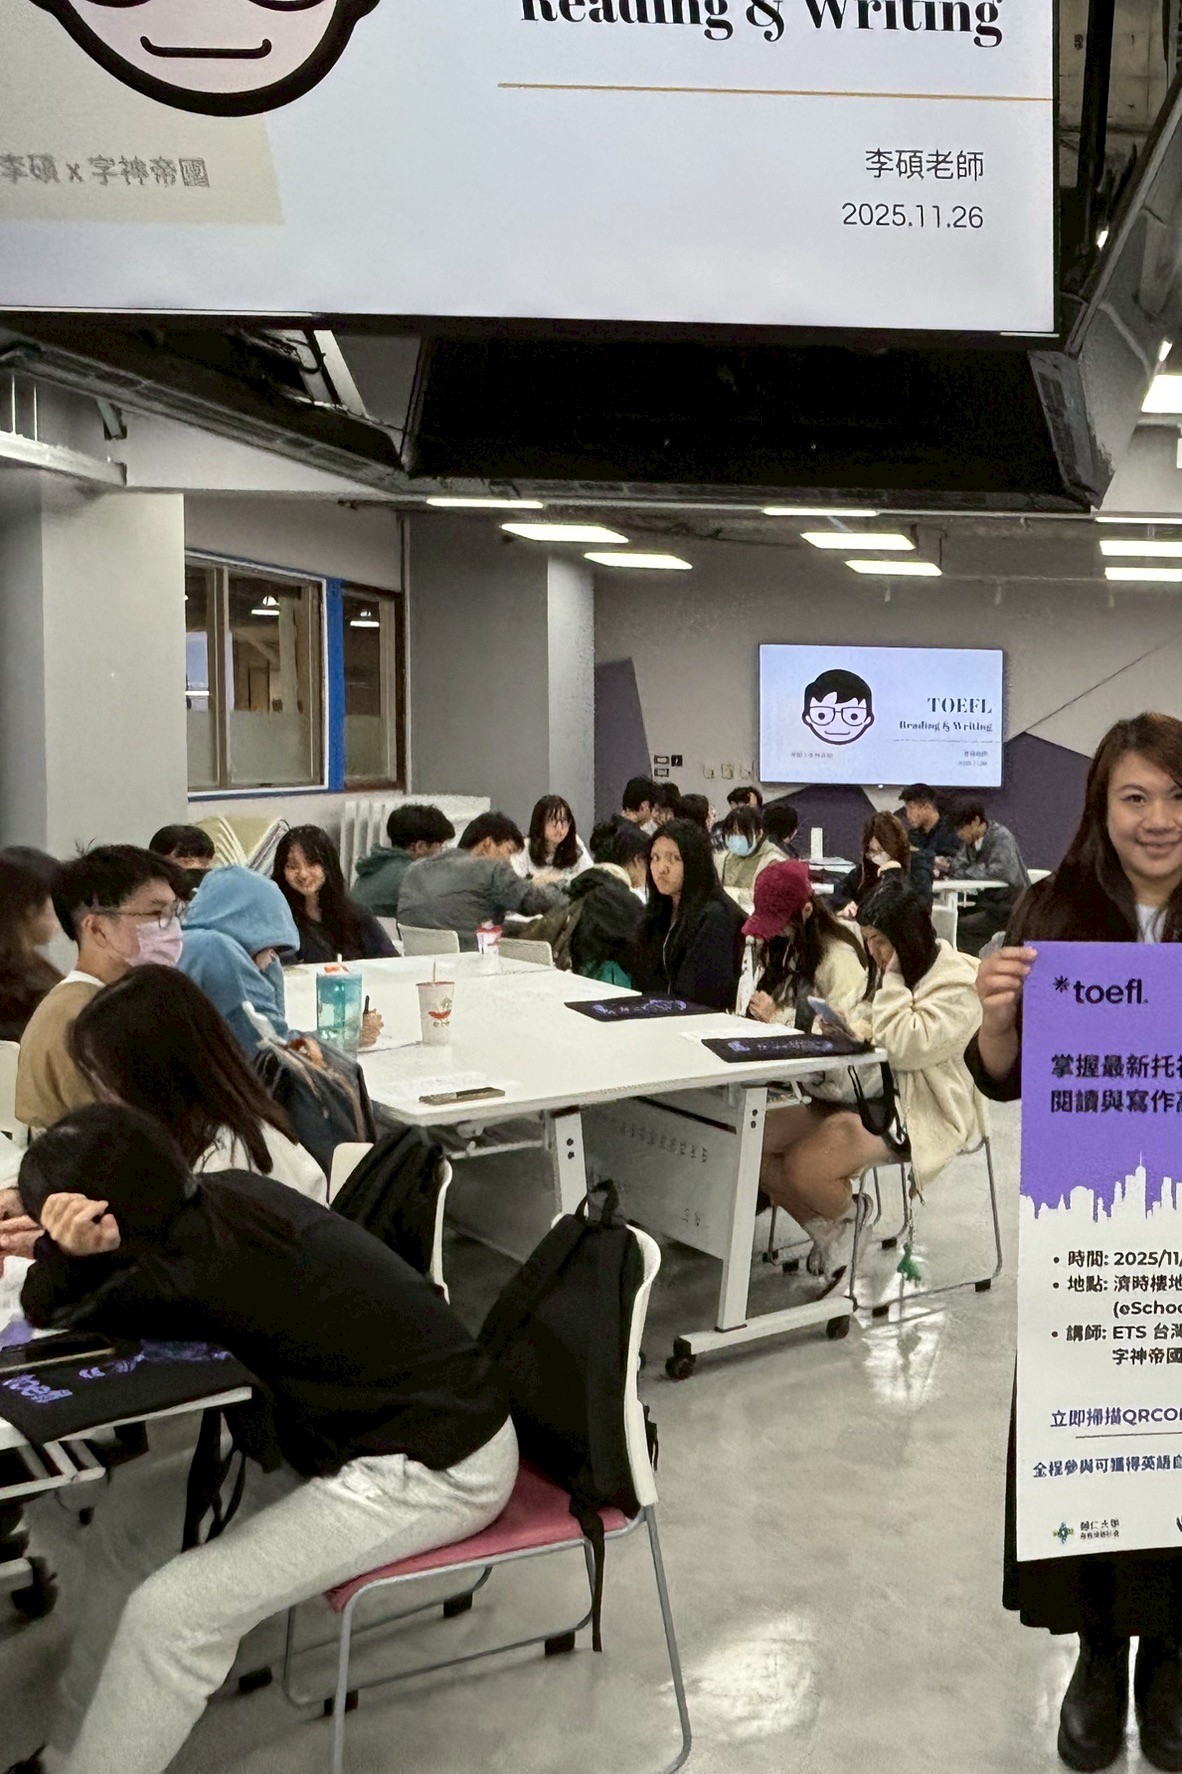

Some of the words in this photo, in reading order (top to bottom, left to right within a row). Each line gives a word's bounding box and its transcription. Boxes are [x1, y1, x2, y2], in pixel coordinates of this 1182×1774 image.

[809, 0, 1003, 47] Writing
[865, 148, 984, 181] 李碩老師
[842, 202, 984, 229] 2025.11.26
[927, 697, 992, 714] TOEFL
[1113, 1325, 1148, 1340] ETS
